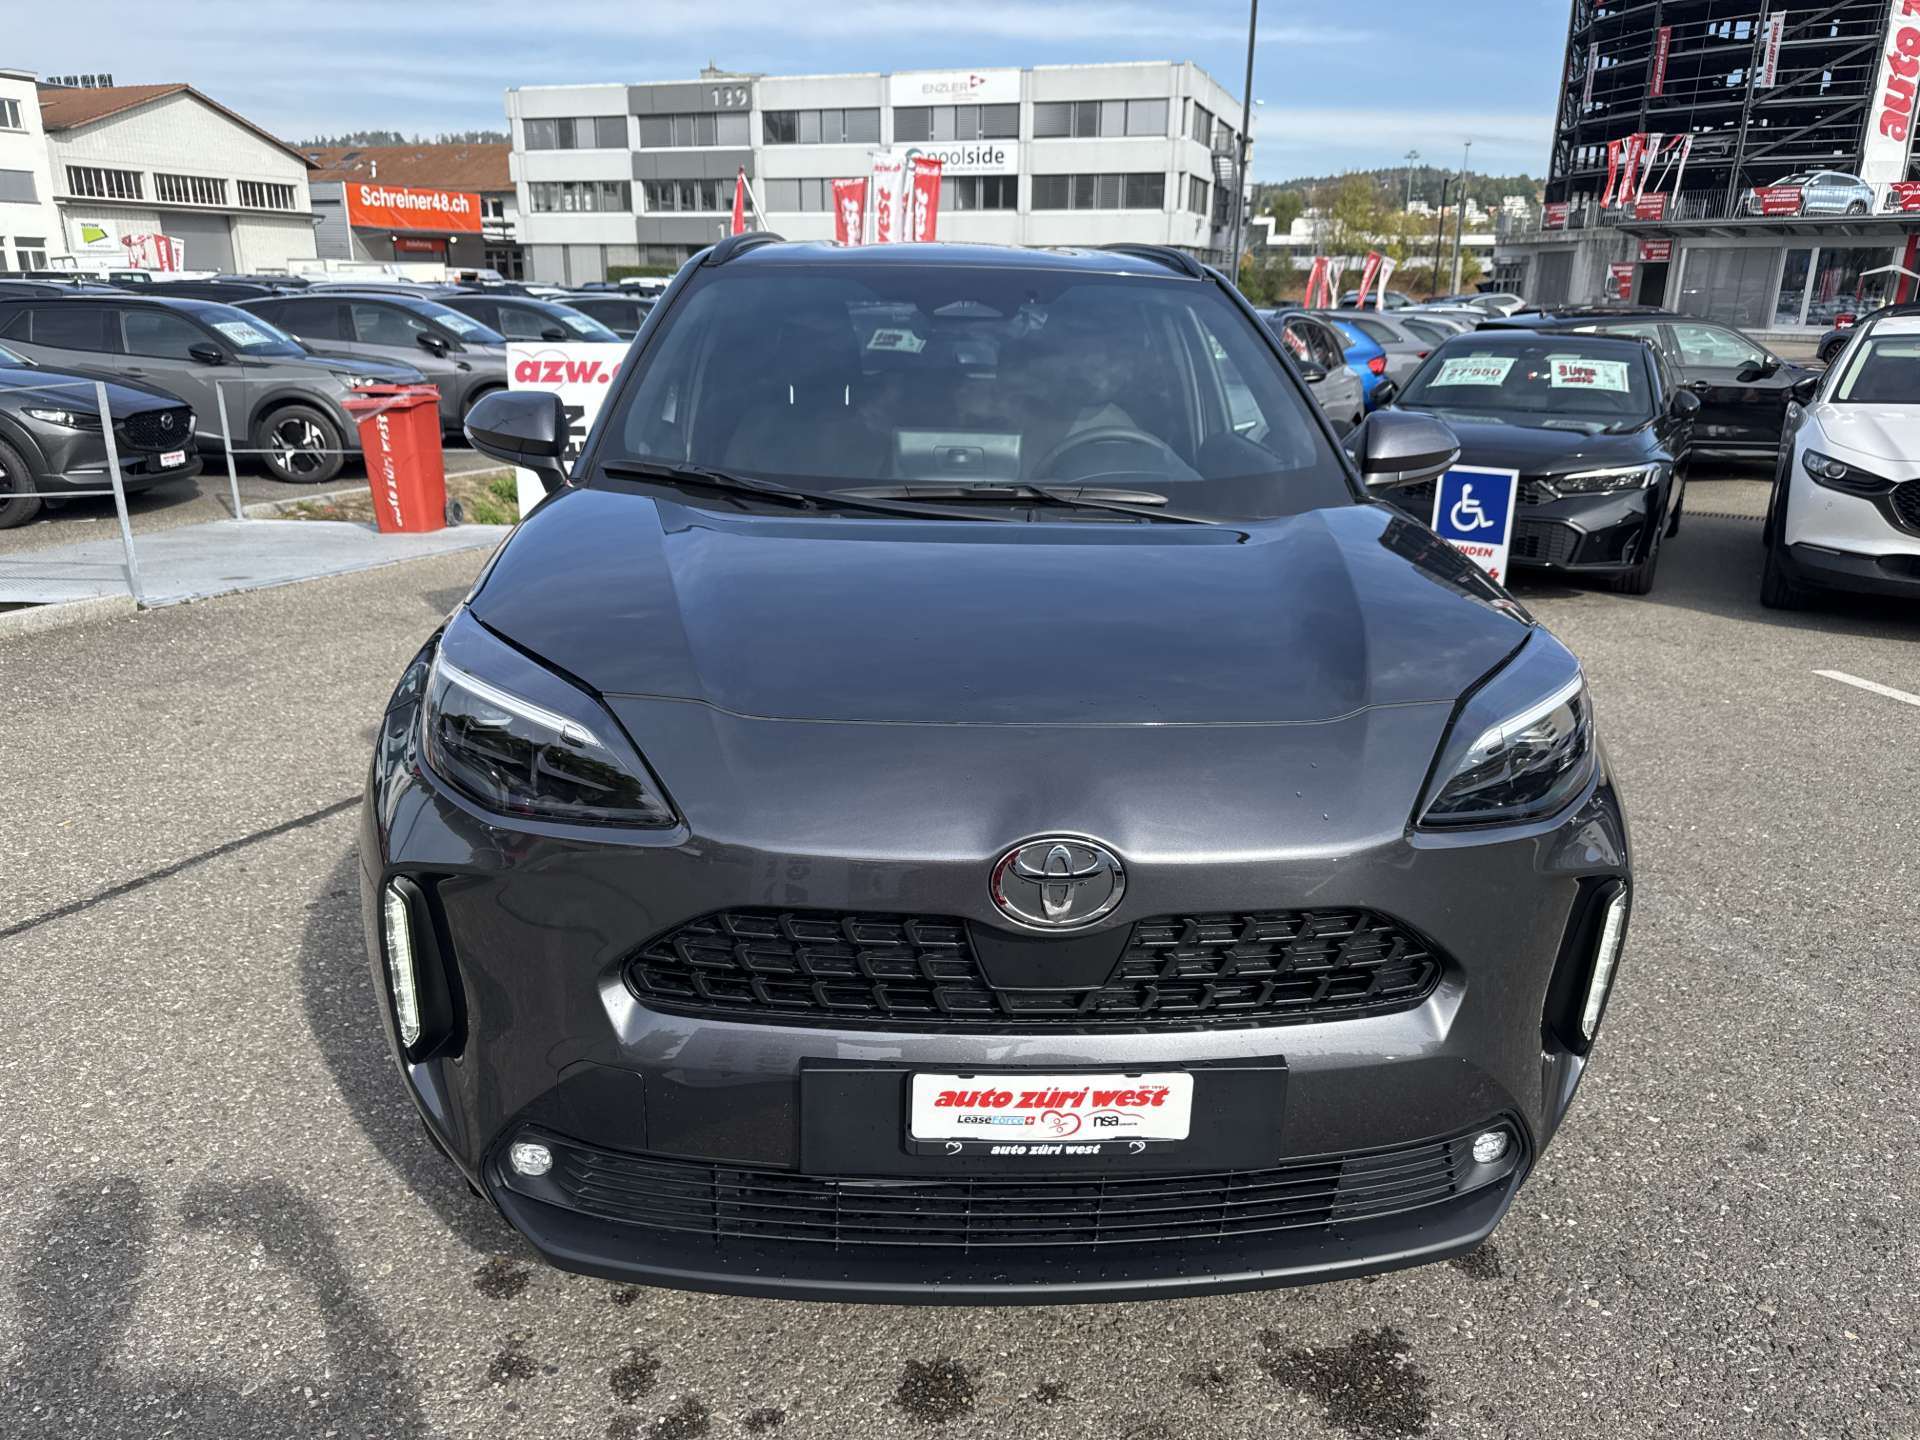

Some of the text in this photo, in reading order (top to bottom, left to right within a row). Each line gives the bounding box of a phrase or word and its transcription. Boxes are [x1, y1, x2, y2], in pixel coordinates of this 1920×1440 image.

[922, 82, 969, 94] ENZLER
[1880, 27, 1920, 142] auto
[712, 89, 747, 106] 139
[360, 185, 470, 213] Schreiner48.ch
[915, 188, 928, 242] est
[376, 414, 392, 452] west
[1457, 545, 1494, 558] NDEN
[934, 1086, 1170, 1108] auto züri west
[957, 1115, 1025, 1126] LeaseForce
[1094, 1115, 1119, 1127] nsa
[990, 1143, 1101, 1155] auto züri west
